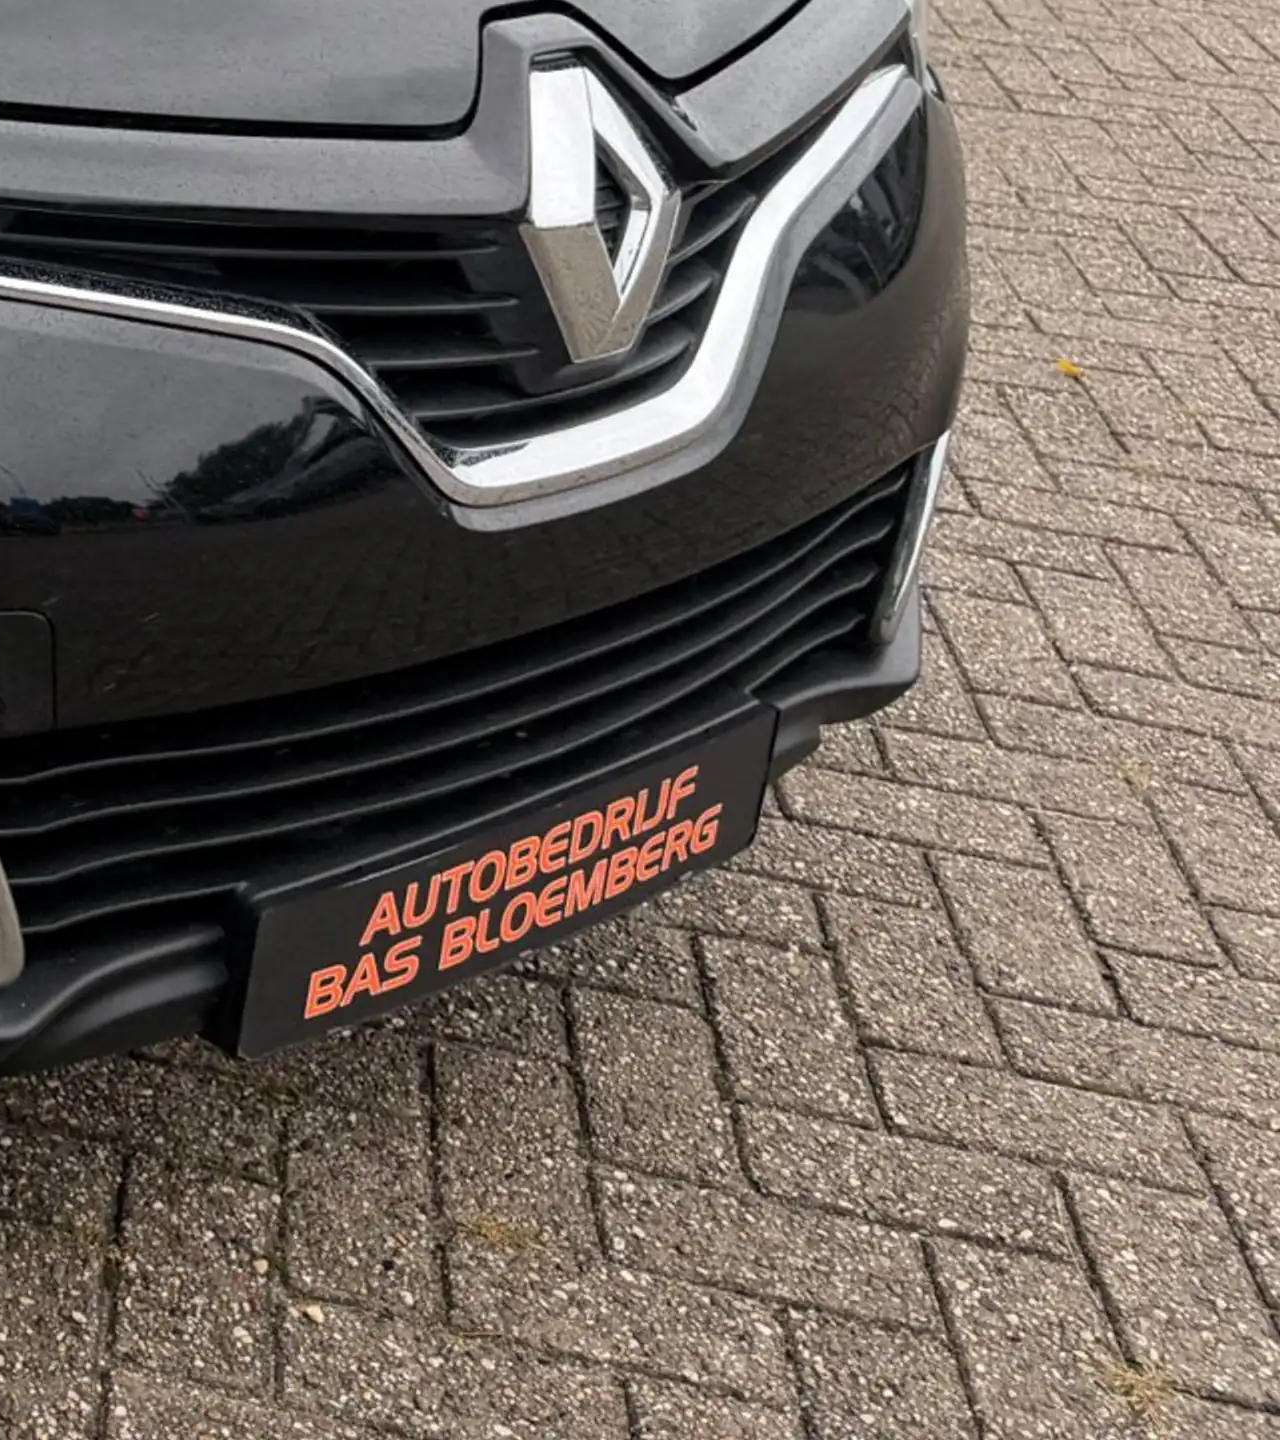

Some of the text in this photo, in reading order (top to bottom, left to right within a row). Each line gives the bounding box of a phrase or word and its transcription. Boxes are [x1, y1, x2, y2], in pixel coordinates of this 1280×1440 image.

[303, 802, 724, 1020] BAS BLOEMBERG
[359, 765, 700, 946] AUTOBEDRIJF
